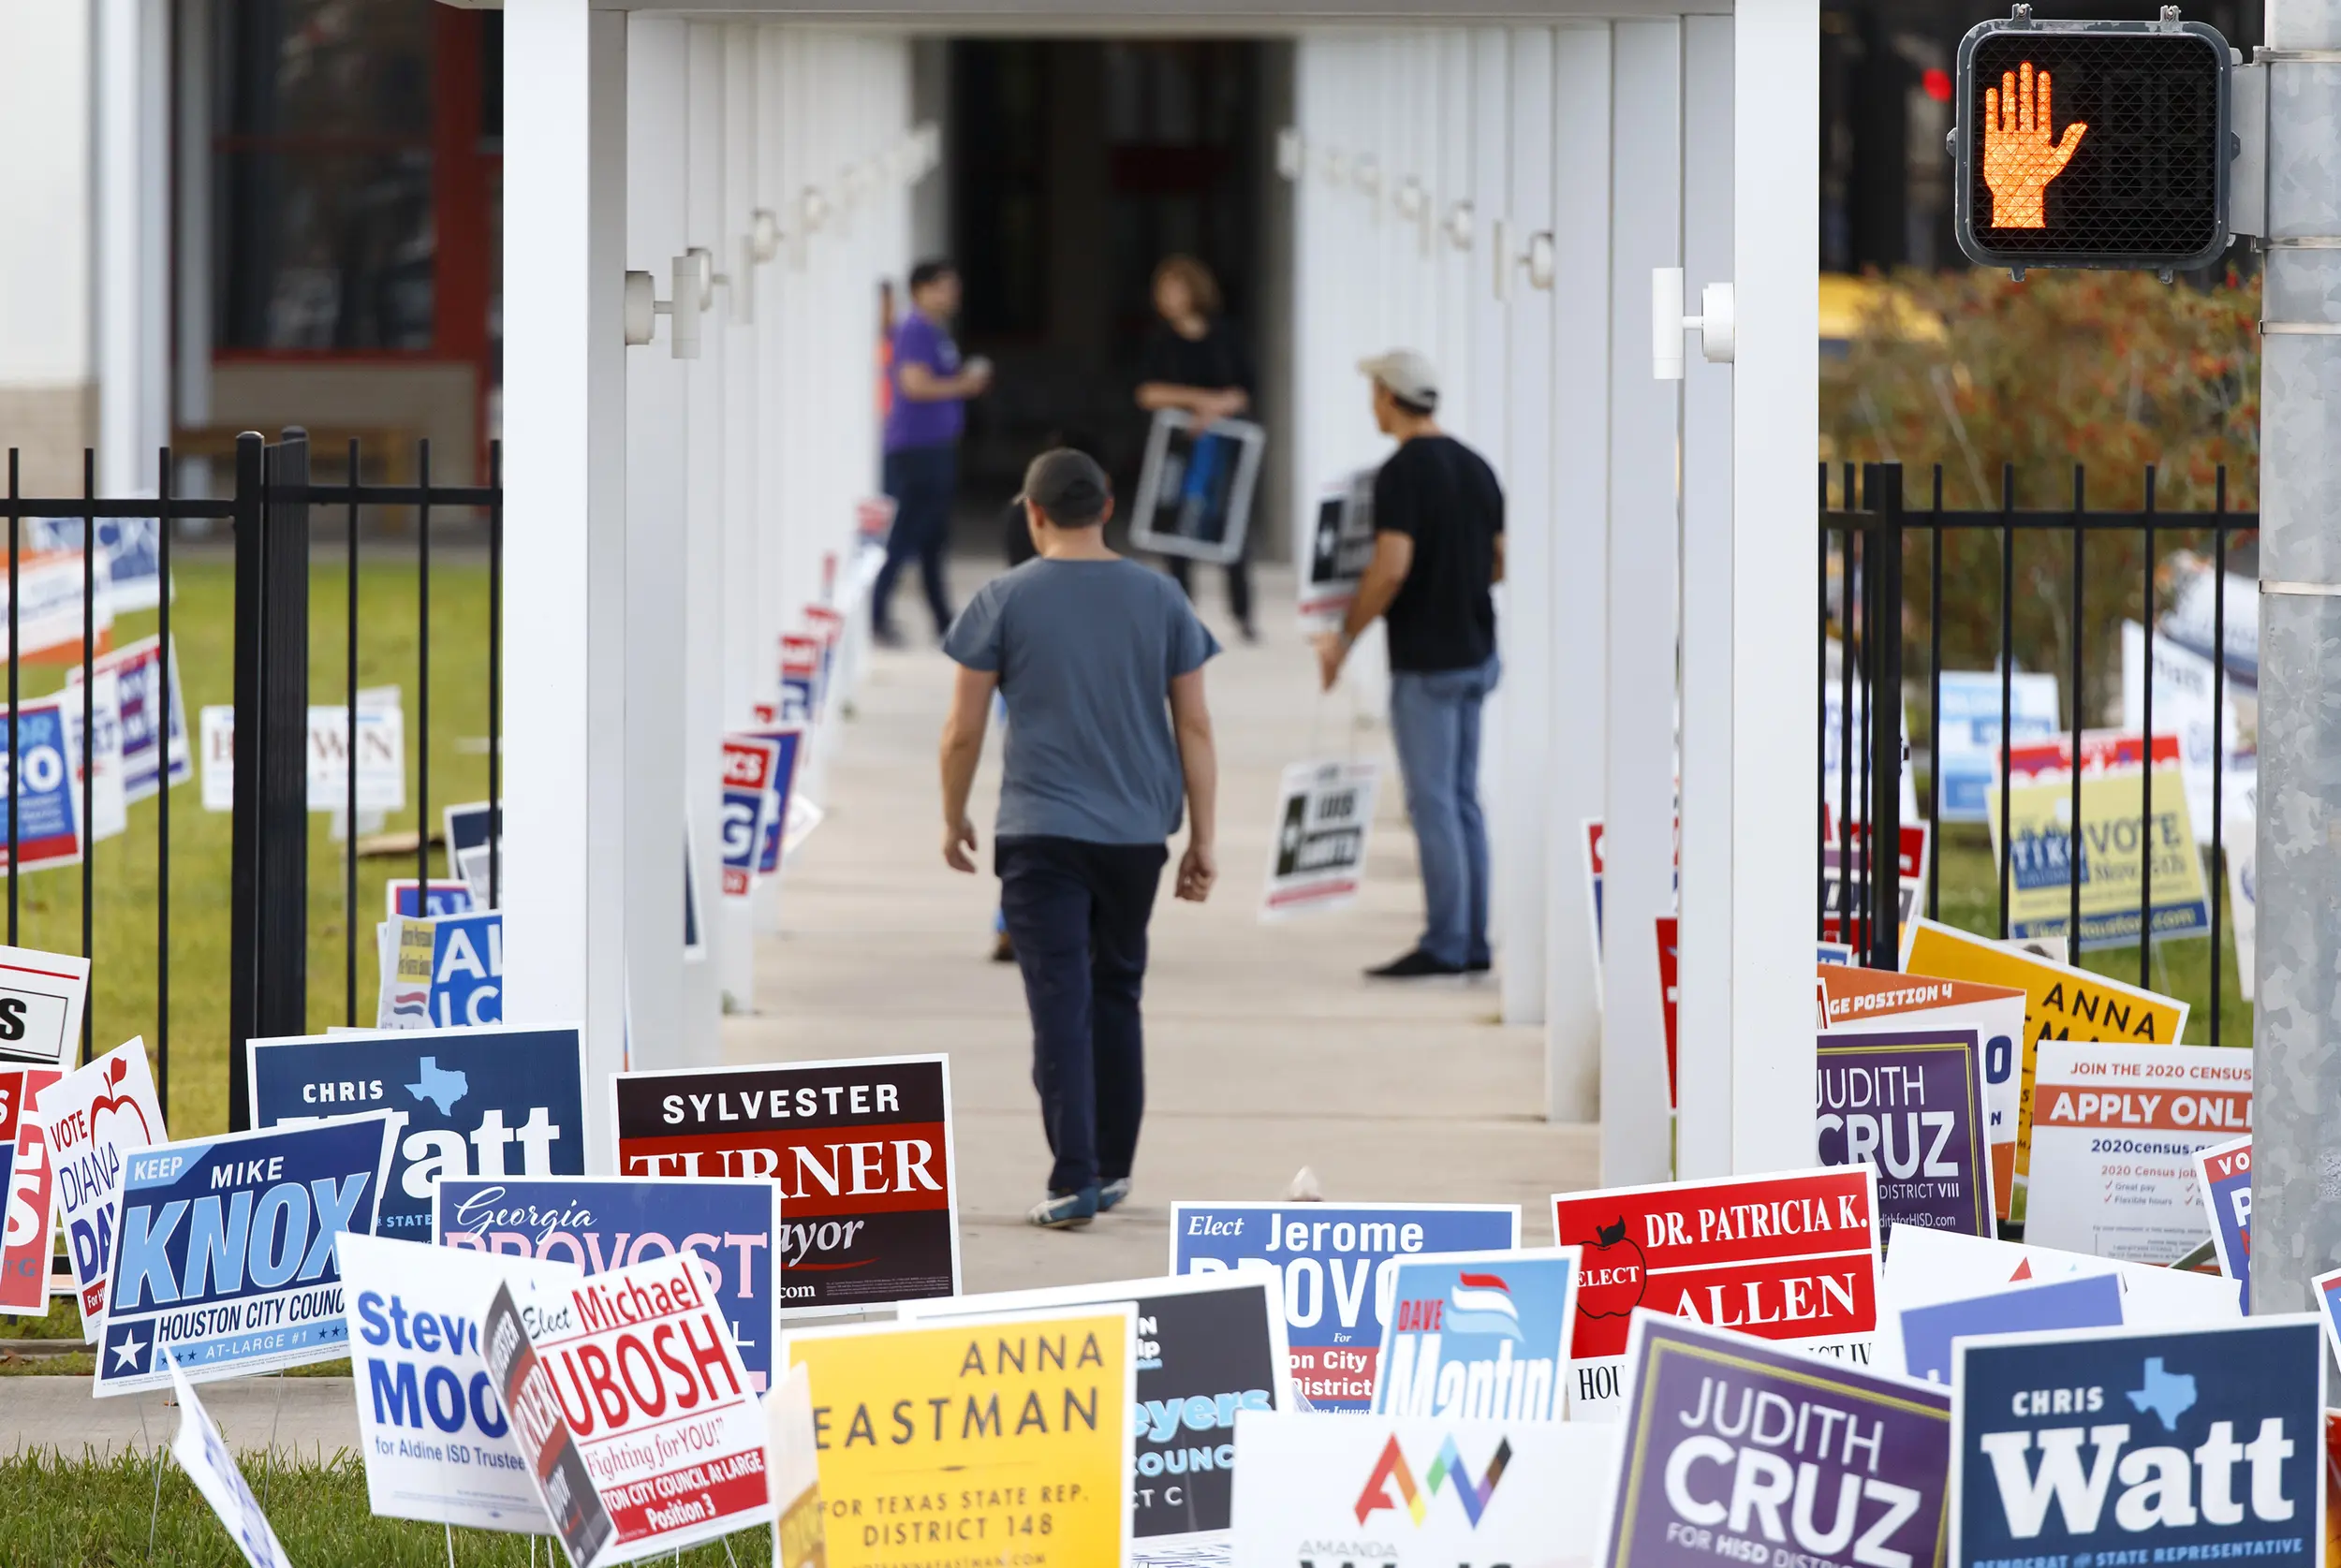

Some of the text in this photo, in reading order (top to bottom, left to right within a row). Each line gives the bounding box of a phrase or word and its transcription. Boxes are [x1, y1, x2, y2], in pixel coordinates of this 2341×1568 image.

[1853, 985, 1938, 1013] POSITION
[1941, 983, 1952, 999] 4
[2041, 981, 2156, 1042] ANNA
[2069, 1062, 2252, 1081] JOIN THE 2020 CENSUS
[302, 1079, 384, 1104] CHRIS
[662, 1083, 900, 1124] SYLVESTER
[2049, 1092, 2163, 1124] APPLY
[50, 1109, 88, 1153] VOTE
[1817, 1110, 1960, 1180] CRUZ
[59, 1141, 120, 1214] DIANA
[134, 1156, 184, 1181] KEEP
[210, 1155, 285, 1190] MIKE
[2101, 1165, 2131, 1176] 2020
[2134, 1166, 2175, 1178] Census
[1878, 1182, 1960, 1201] DISTRICT VIII
[453, 1185, 599, 1246] Georgia
[1186, 1213, 1425, 1253] Elect Jerome
[1643, 1194, 1868, 1249] DR. PATRICIA K.
[114, 1171, 372, 1311] KNOX
[1577, 1265, 1640, 1288] ELECT
[523, 1305, 572, 1340] Elect
[571, 1261, 705, 1337] Michael
[1397, 1298, 1445, 1332] DAVE
[1674, 1271, 1857, 1327] ALLEN
[158, 1305, 242, 1342] HOUSTON
[245, 1297, 287, 1327] CITY
[1332, 1331, 1352, 1343] For
[205, 1329, 308, 1359] AT-LARGE #1
[959, 1330, 1104, 1378] ANNA
[1322, 1348, 1368, 1377] City
[813, 1386, 1098, 1452] EASTMAN
[2011, 1385, 2104, 1417] CHRIS
[1678, 1376, 1884, 1473] JUDITH
[375, 1434, 526, 1472] for Aldine ISD Trustee
[585, 1431, 655, 1481] Fighting
[1134, 1443, 1235, 1478] OUNC
[628, 1480, 657, 1506] CITY
[655, 1465, 711, 1499] COUNCIL
[722, 1452, 765, 1481] LARGE
[1980, 1416, 2295, 1540] Watt
[644, 1492, 717, 1531] Position 3
[876, 1492, 948, 1516] TEXAS
[962, 1487, 1027, 1511] STATE
[1040, 1483, 1090, 1503] REP.
[1664, 1434, 1921, 1568] CRUZ
[863, 1513, 1053, 1547] DISTRICT 148
[1297, 1539, 1398, 1559] AMANDA
[1666, 1521, 1713, 1549] FOR
[1715, 1534, 1769, 1564] HISD
[2096, 1548, 2149, 1568] STATE
[2153, 1537, 2304, 1564] REPRESENTATIVE
